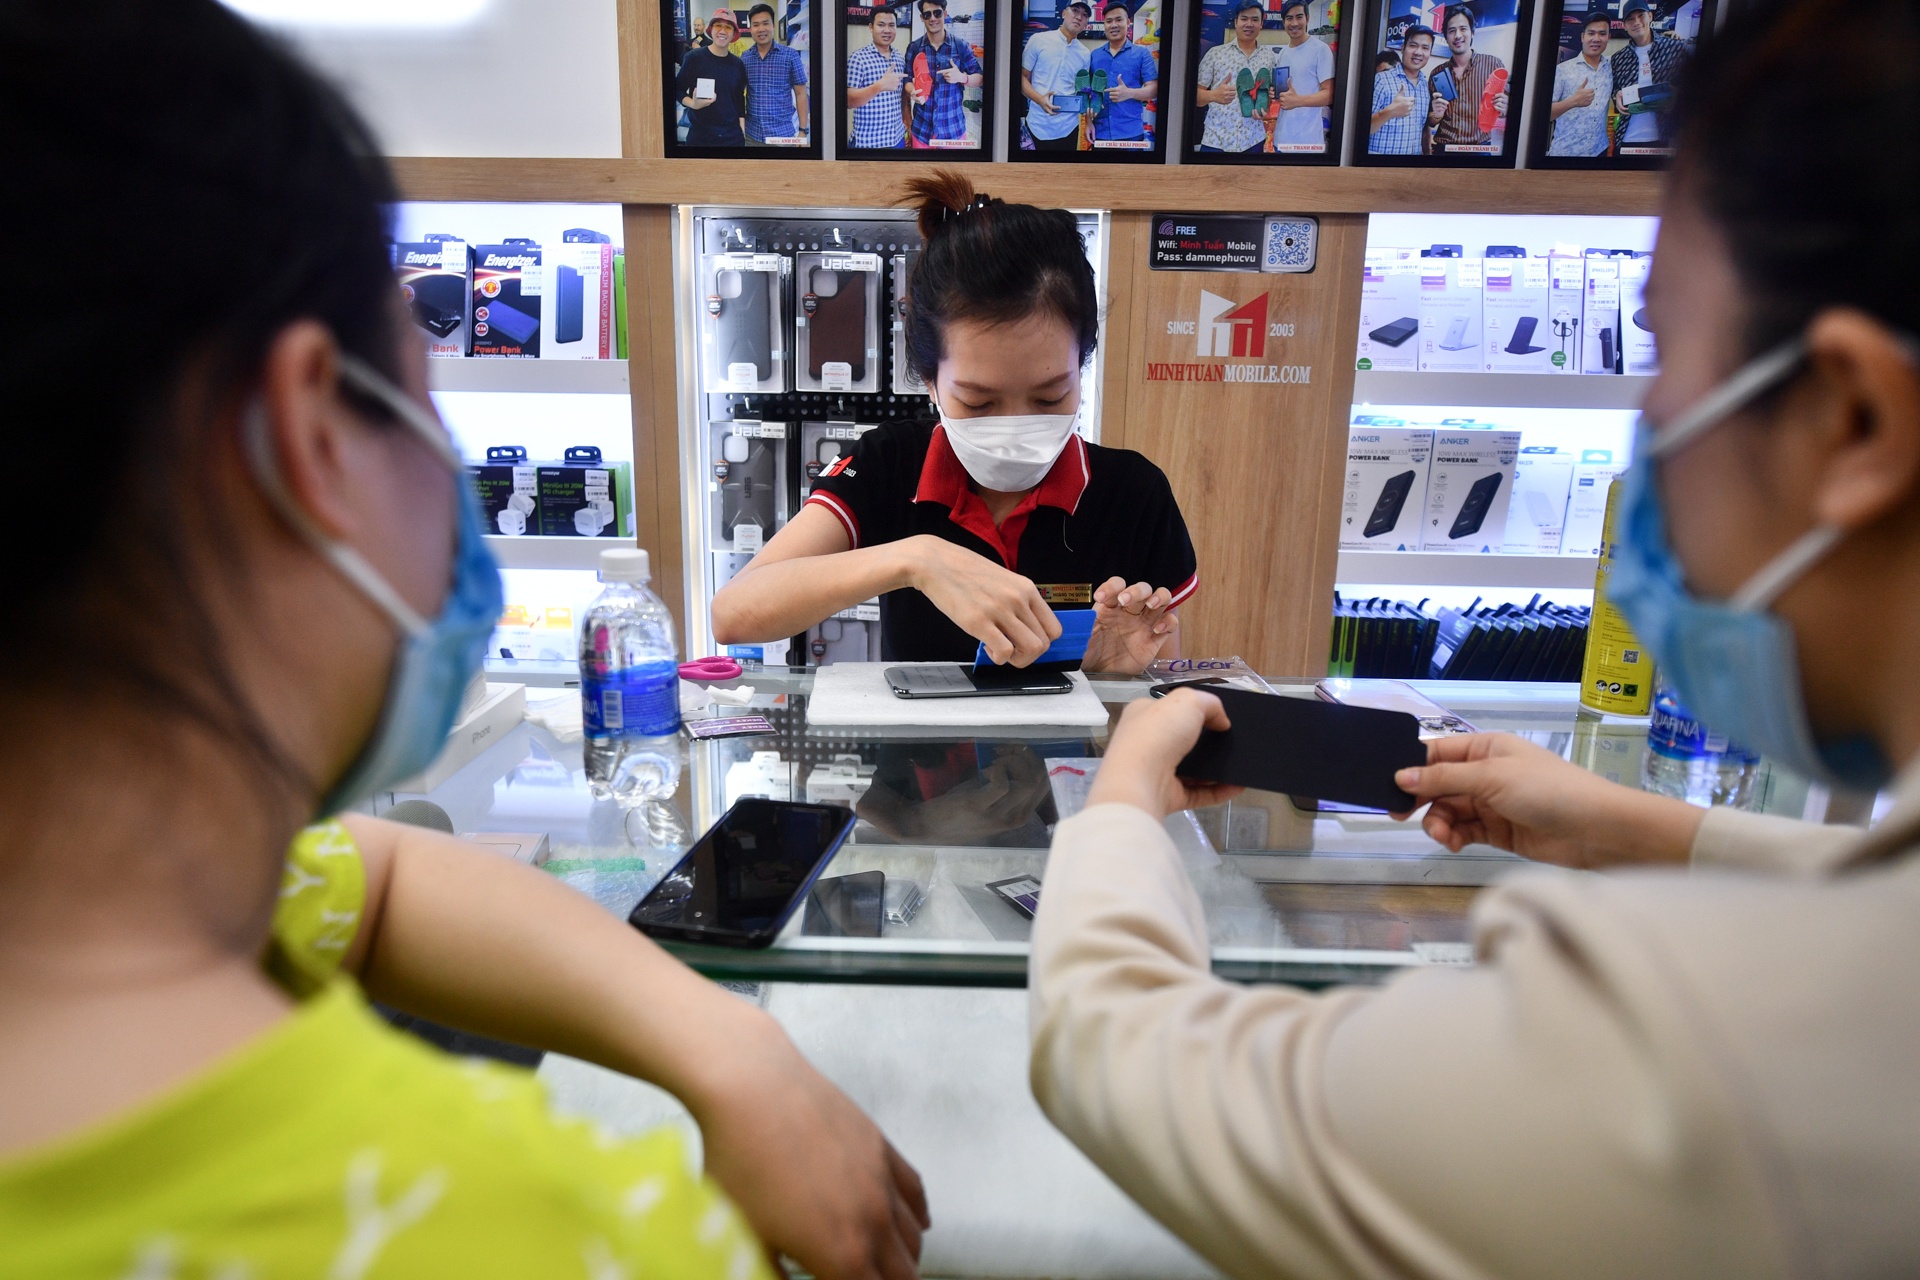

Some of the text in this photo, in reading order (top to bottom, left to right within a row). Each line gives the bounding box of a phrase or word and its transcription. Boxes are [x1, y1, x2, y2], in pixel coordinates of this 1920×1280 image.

[1175, 226, 1197, 235] FREE
[1158, 238, 1257, 251] Wifi: Minh Tuấn Mobile
[1157, 252, 1256, 264] Pass: dammephucvu
[601, 247, 610, 288] ULTRA-SLIM
[601, 290, 609, 318] BACKUP
[600, 319, 608, 349] BATTERY
[1167, 321, 1295, 337] SINCE 2003
[432, 344, 459, 353] Bank
[474, 346, 522, 354] Power Bank
[1147, 363, 1311, 384] MINHTUANMOBILE.COM
[1168, 659, 1235, 673] Clear
[472, 724, 492, 745] iPhone
